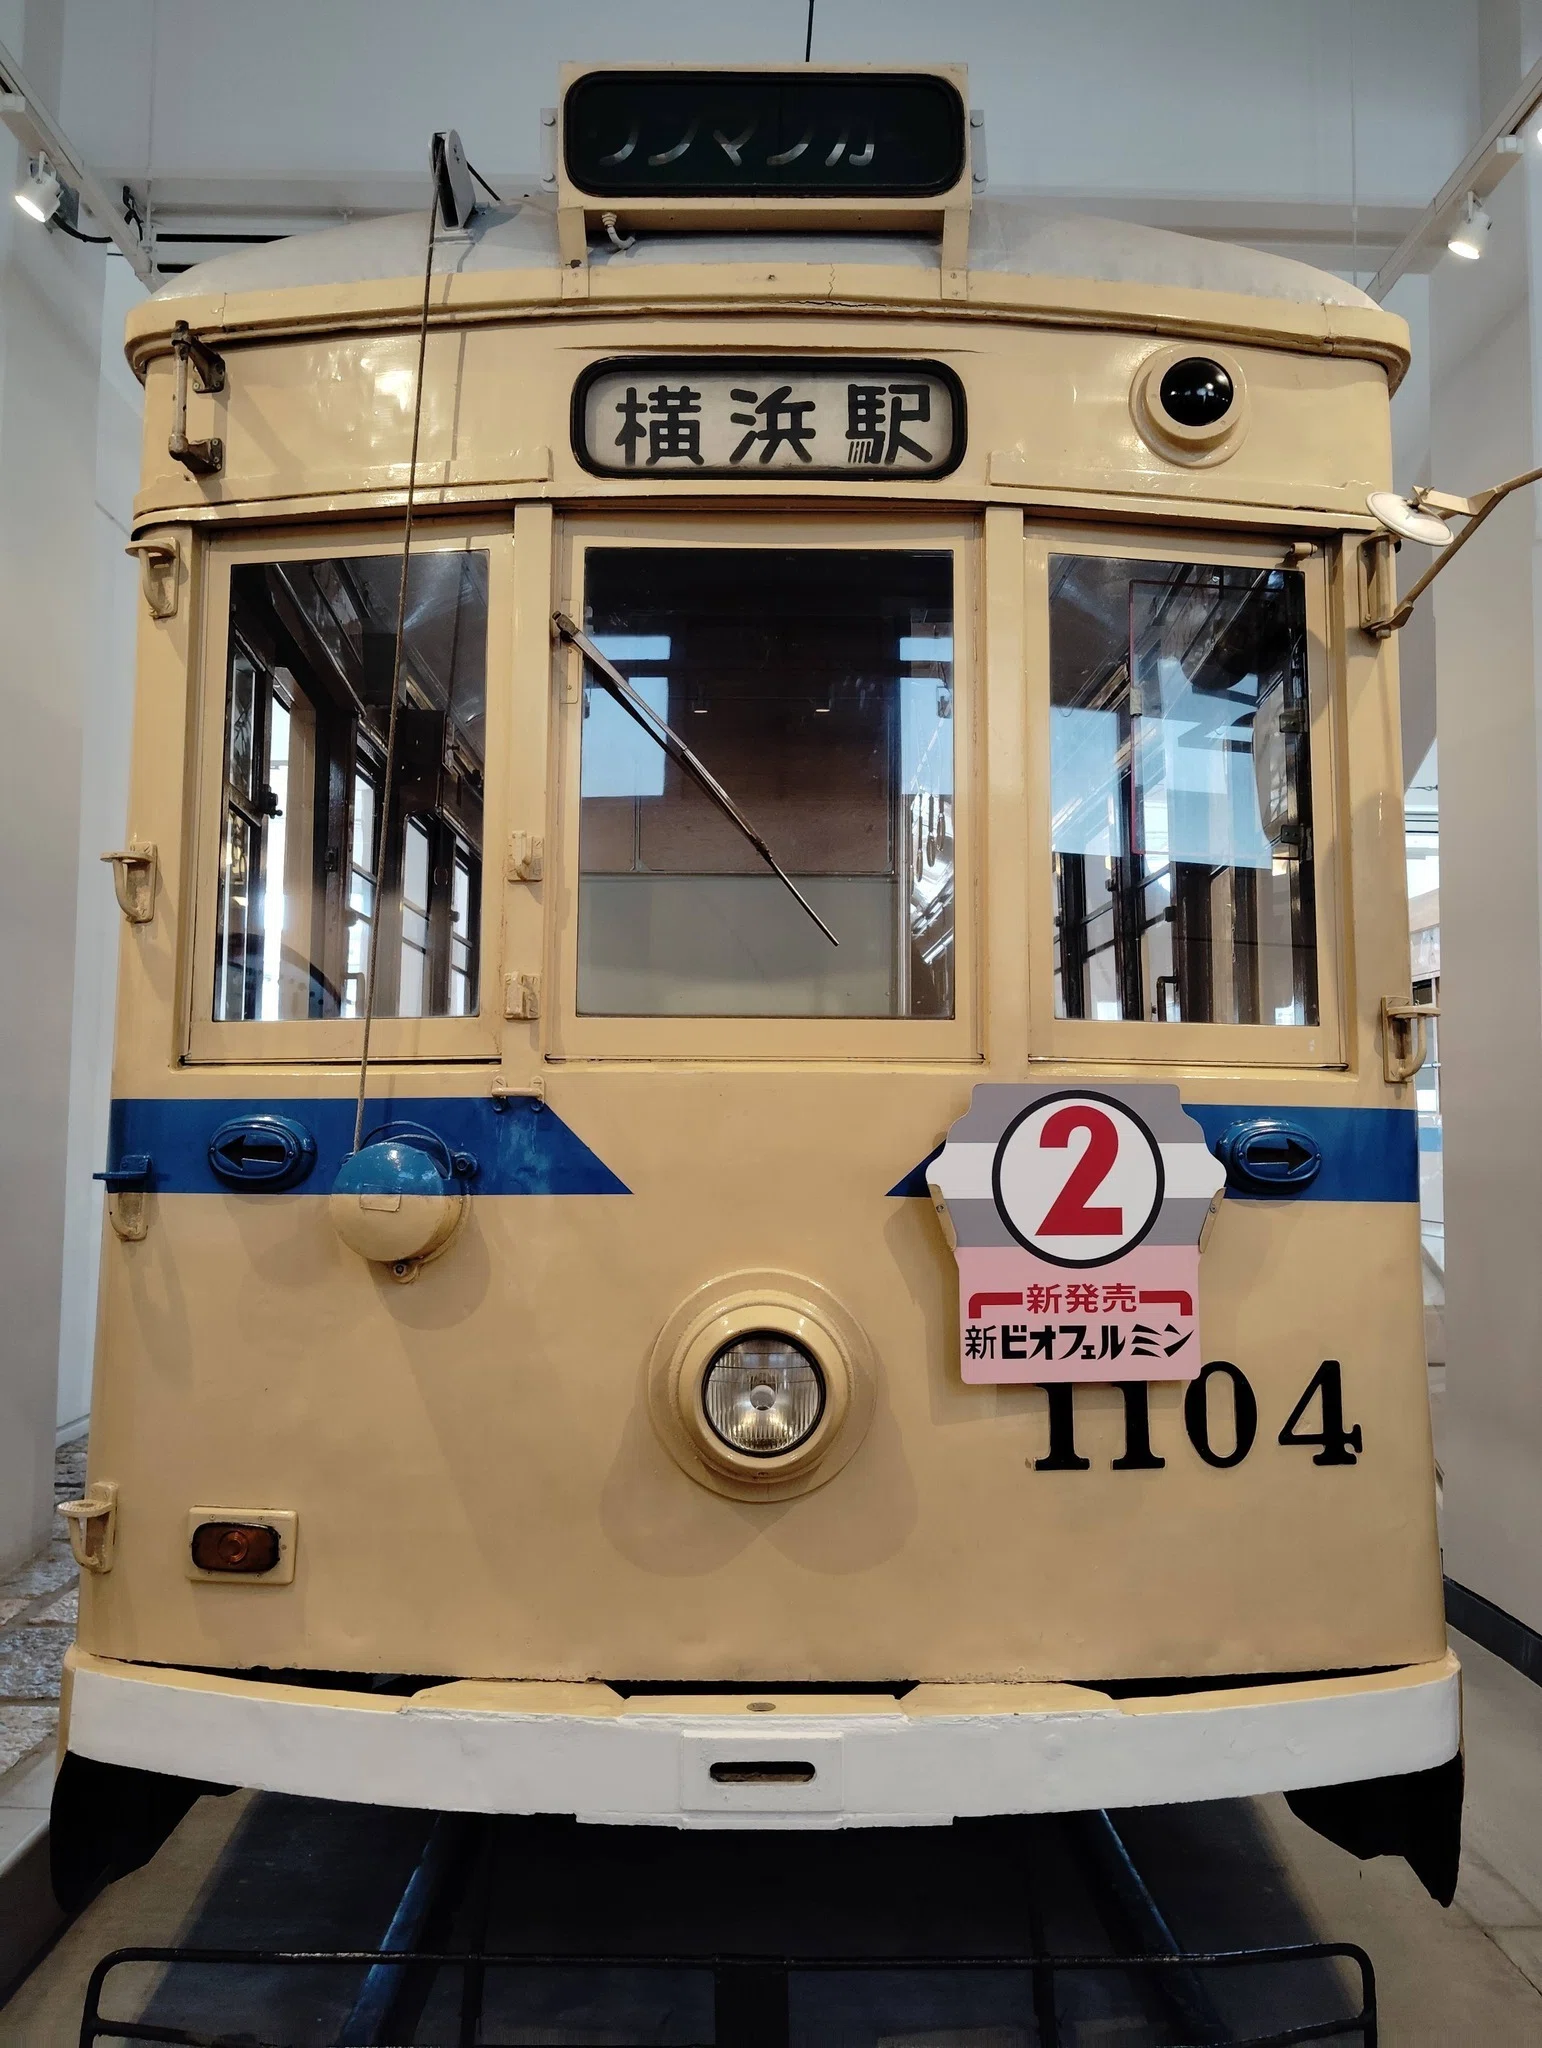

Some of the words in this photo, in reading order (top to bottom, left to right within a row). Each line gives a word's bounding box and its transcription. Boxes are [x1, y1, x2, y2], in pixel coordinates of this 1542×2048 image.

[615, 383, 933, 466] 横浜駅
[1035, 1105, 1123, 1236] 2
[1026, 1283, 1137, 1313] 新発売
[964, 1323, 1195, 1361] 新ビオフェルミン
[1033, 1360, 1363, 1471] 1104
